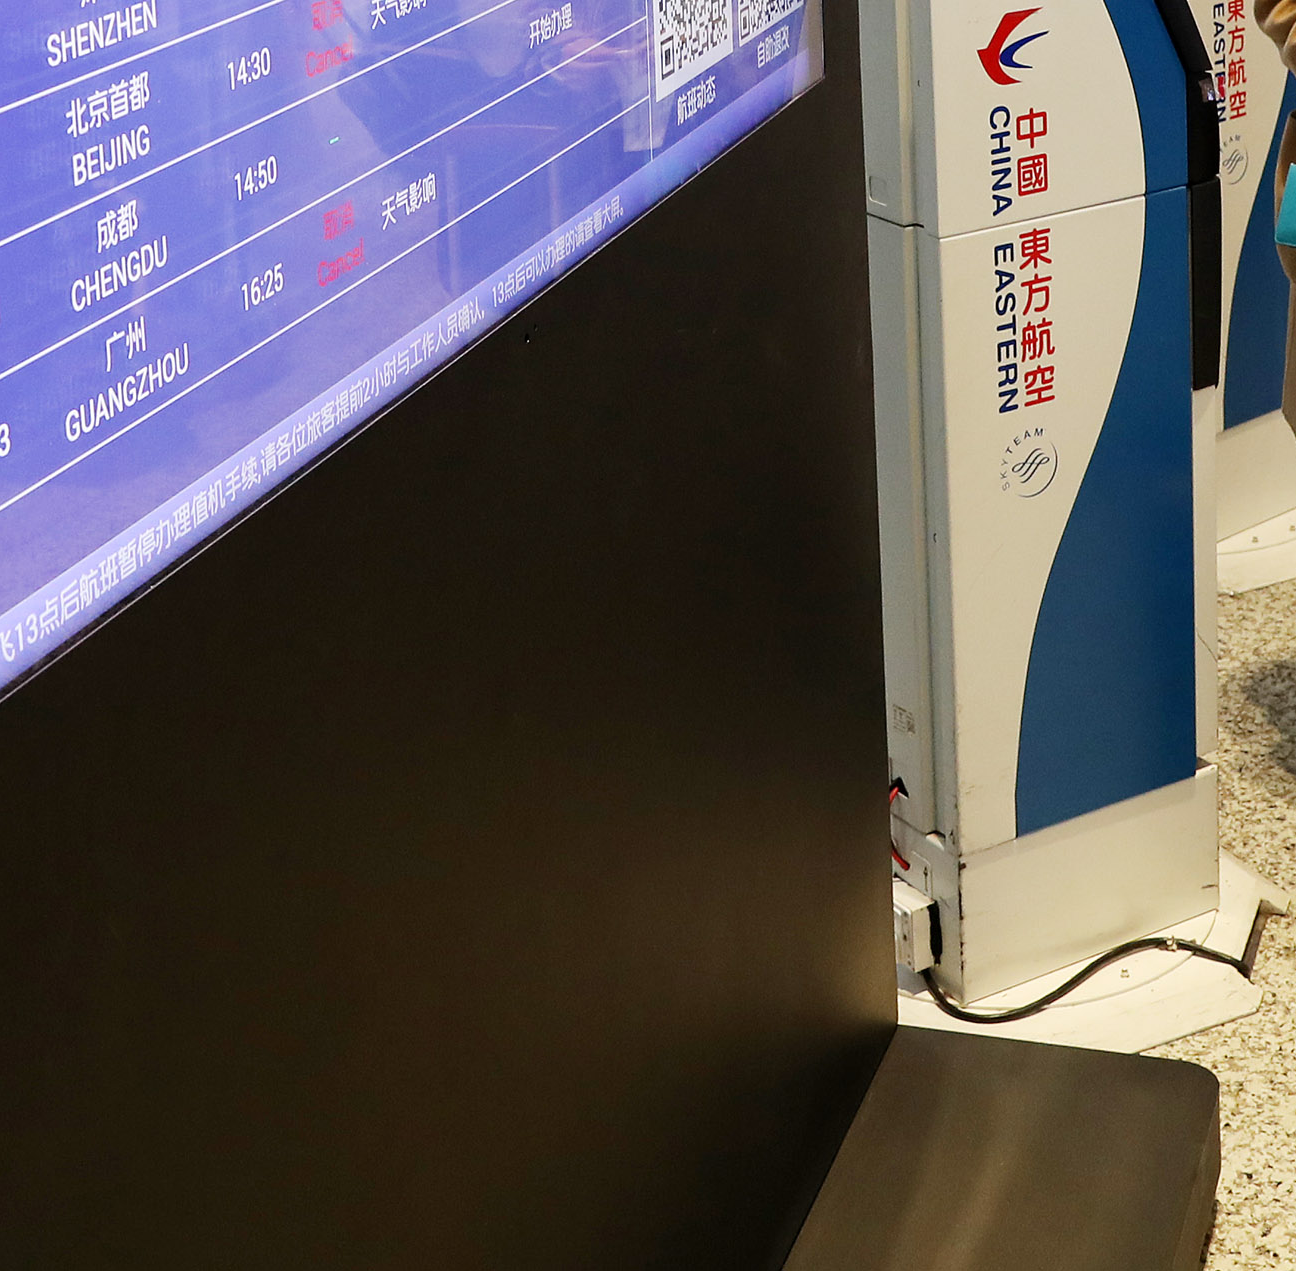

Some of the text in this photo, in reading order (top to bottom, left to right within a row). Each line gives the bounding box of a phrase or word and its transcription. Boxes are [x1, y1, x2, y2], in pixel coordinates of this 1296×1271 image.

[528, 2, 573, 49] 开始办理
[757, 25, 790, 69] 自助退改
[227, 47, 271, 91] 14:30
[305, 35, 354, 78] Cancel
[65, 70, 150, 139] 北京首都
[677, 74, 716, 125] 航班动态
[72, 124, 151, 187] BEIJING
[234, 155, 277, 201] 14:50
[96, 199, 138, 254] 成都
[381, 172, 437, 231] 天气影响
[70, 235, 168, 312] CHENGDU
[317, 237, 365, 287] Cancel
[989, 105, 1018, 414] CHINA EASTERN
[1015, 107, 1057, 410] 中國東方航空
[240, 262, 284, 312] 16:25
[105, 316, 147, 373] 广州
[64, 343, 190, 443] GUANGZHOU
[999, 427, 1046, 492] SKYTEAM
